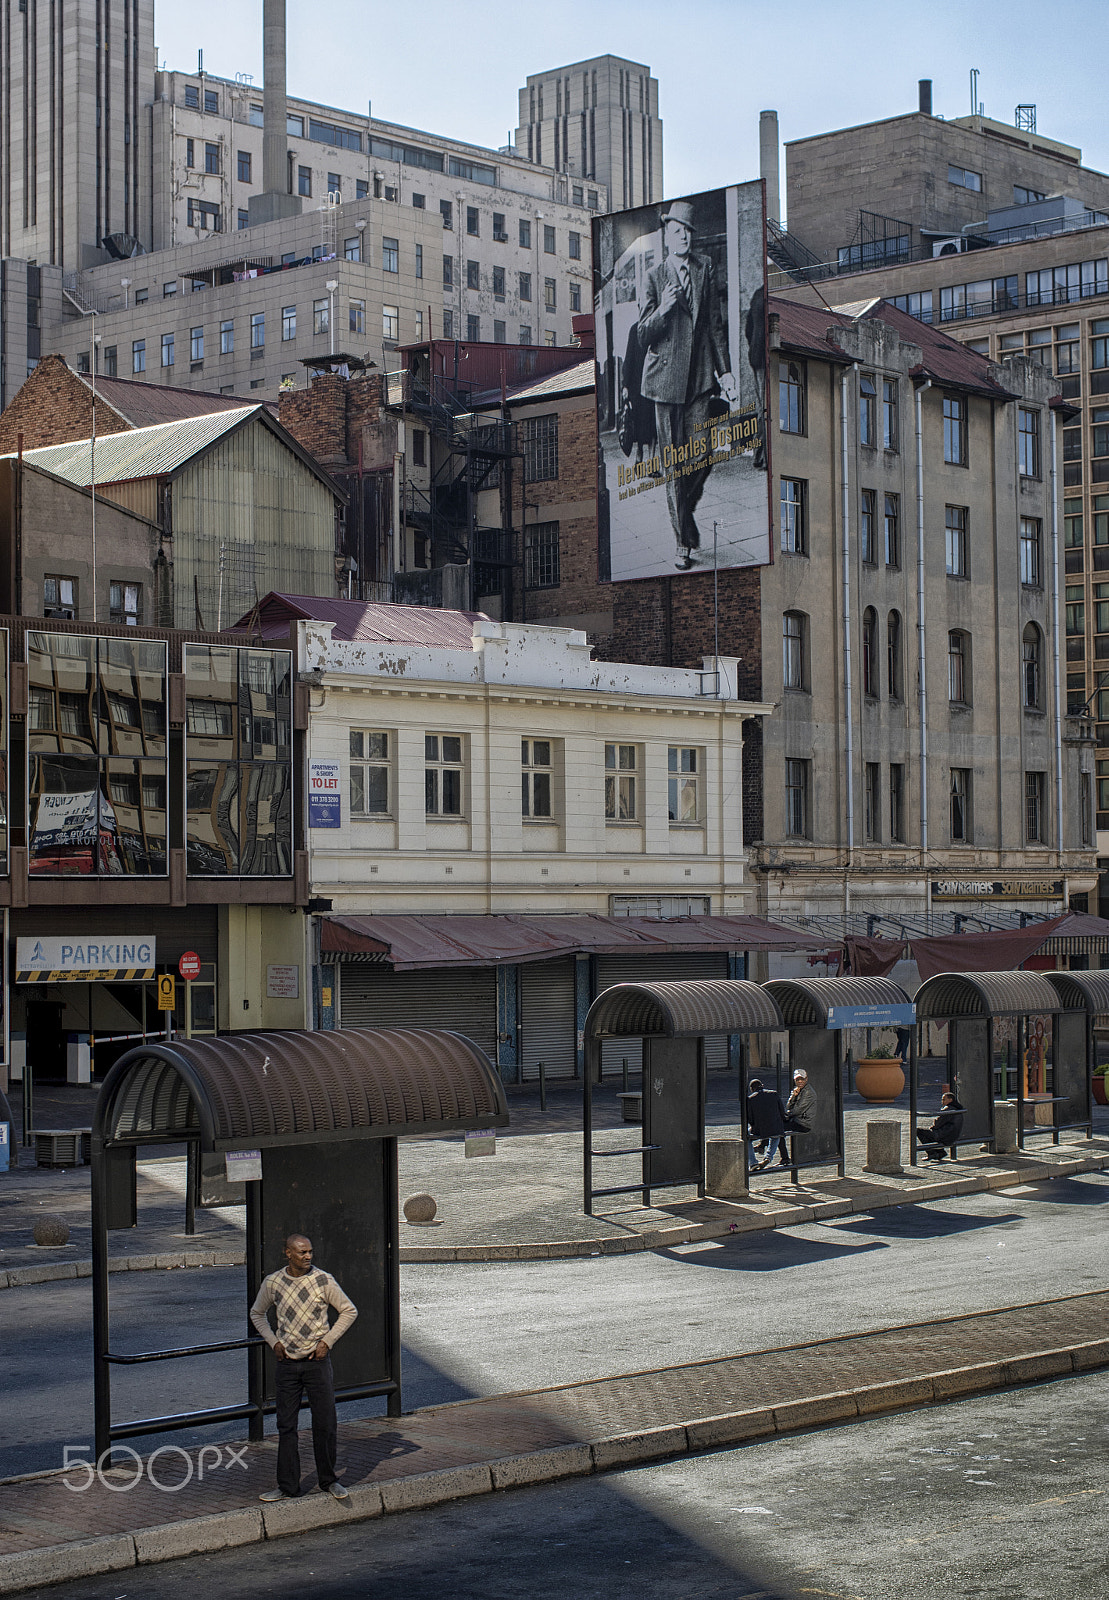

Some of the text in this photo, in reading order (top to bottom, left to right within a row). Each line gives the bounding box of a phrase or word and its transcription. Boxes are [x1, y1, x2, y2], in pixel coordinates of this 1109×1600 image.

[693, 423, 703, 433] The
[703, 416, 719, 431] writer
[719, 410, 729, 423] and
[617, 417, 758, 486] Herman Charles Bosman
[618, 438, 762, 501] had his offices here at the High Court Building in the 1940s
[311, 778, 338, 788] TO LET
[937, 881, 958, 894] Solly
[1001, 881, 1021, 894] Solly
[1021, 881, 1055, 894] Kramers
[61, 944, 151, 964] PARKING
